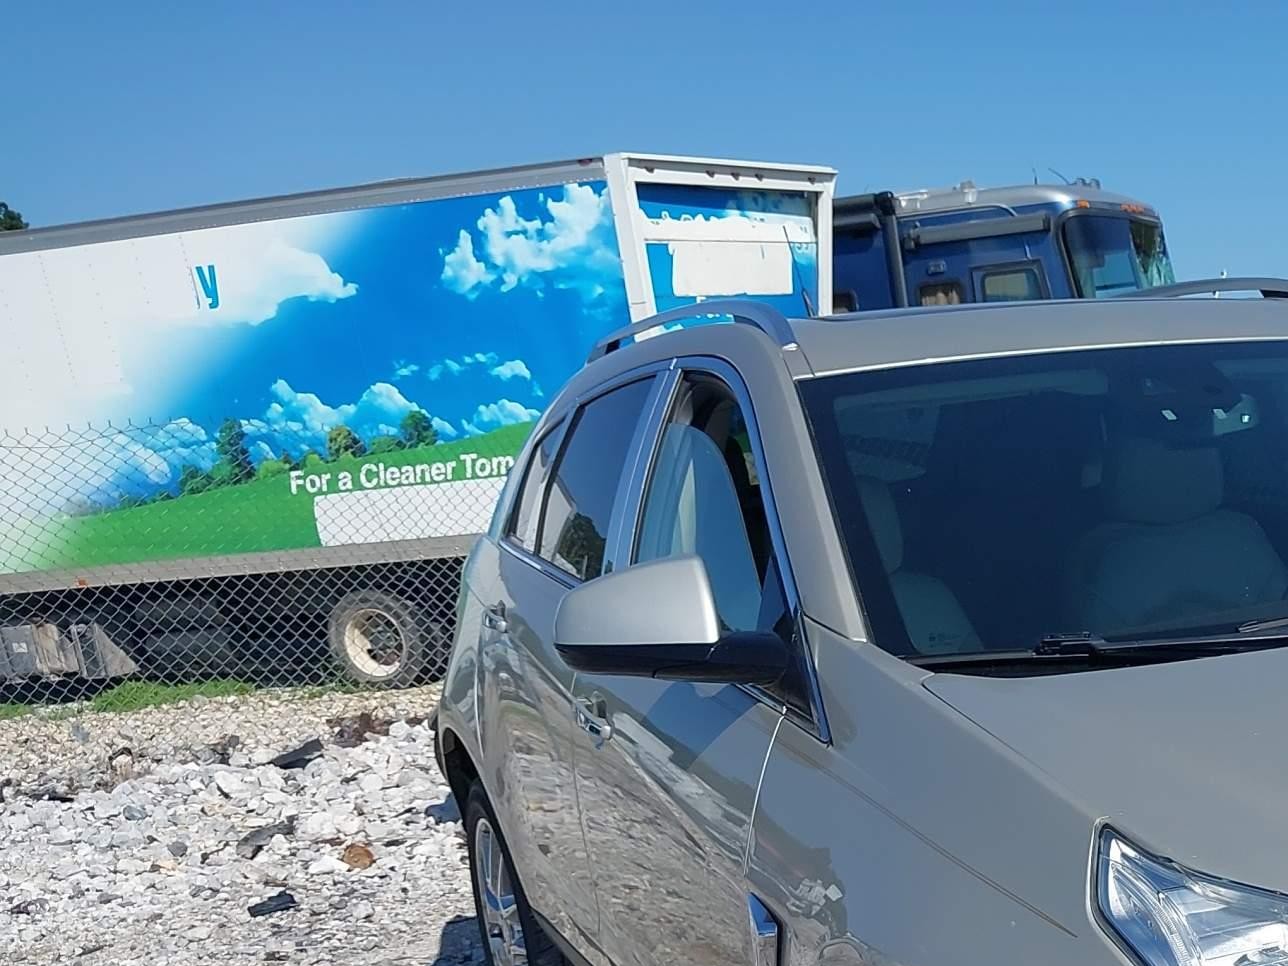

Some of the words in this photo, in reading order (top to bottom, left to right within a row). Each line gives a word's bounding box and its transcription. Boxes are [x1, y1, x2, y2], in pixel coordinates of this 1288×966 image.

[195, 264, 219, 309] y
[289, 470, 331, 495] For
[338, 471, 353, 490] a
[360, 460, 457, 489] Cleaner
[460, 453, 514, 479] Tom
